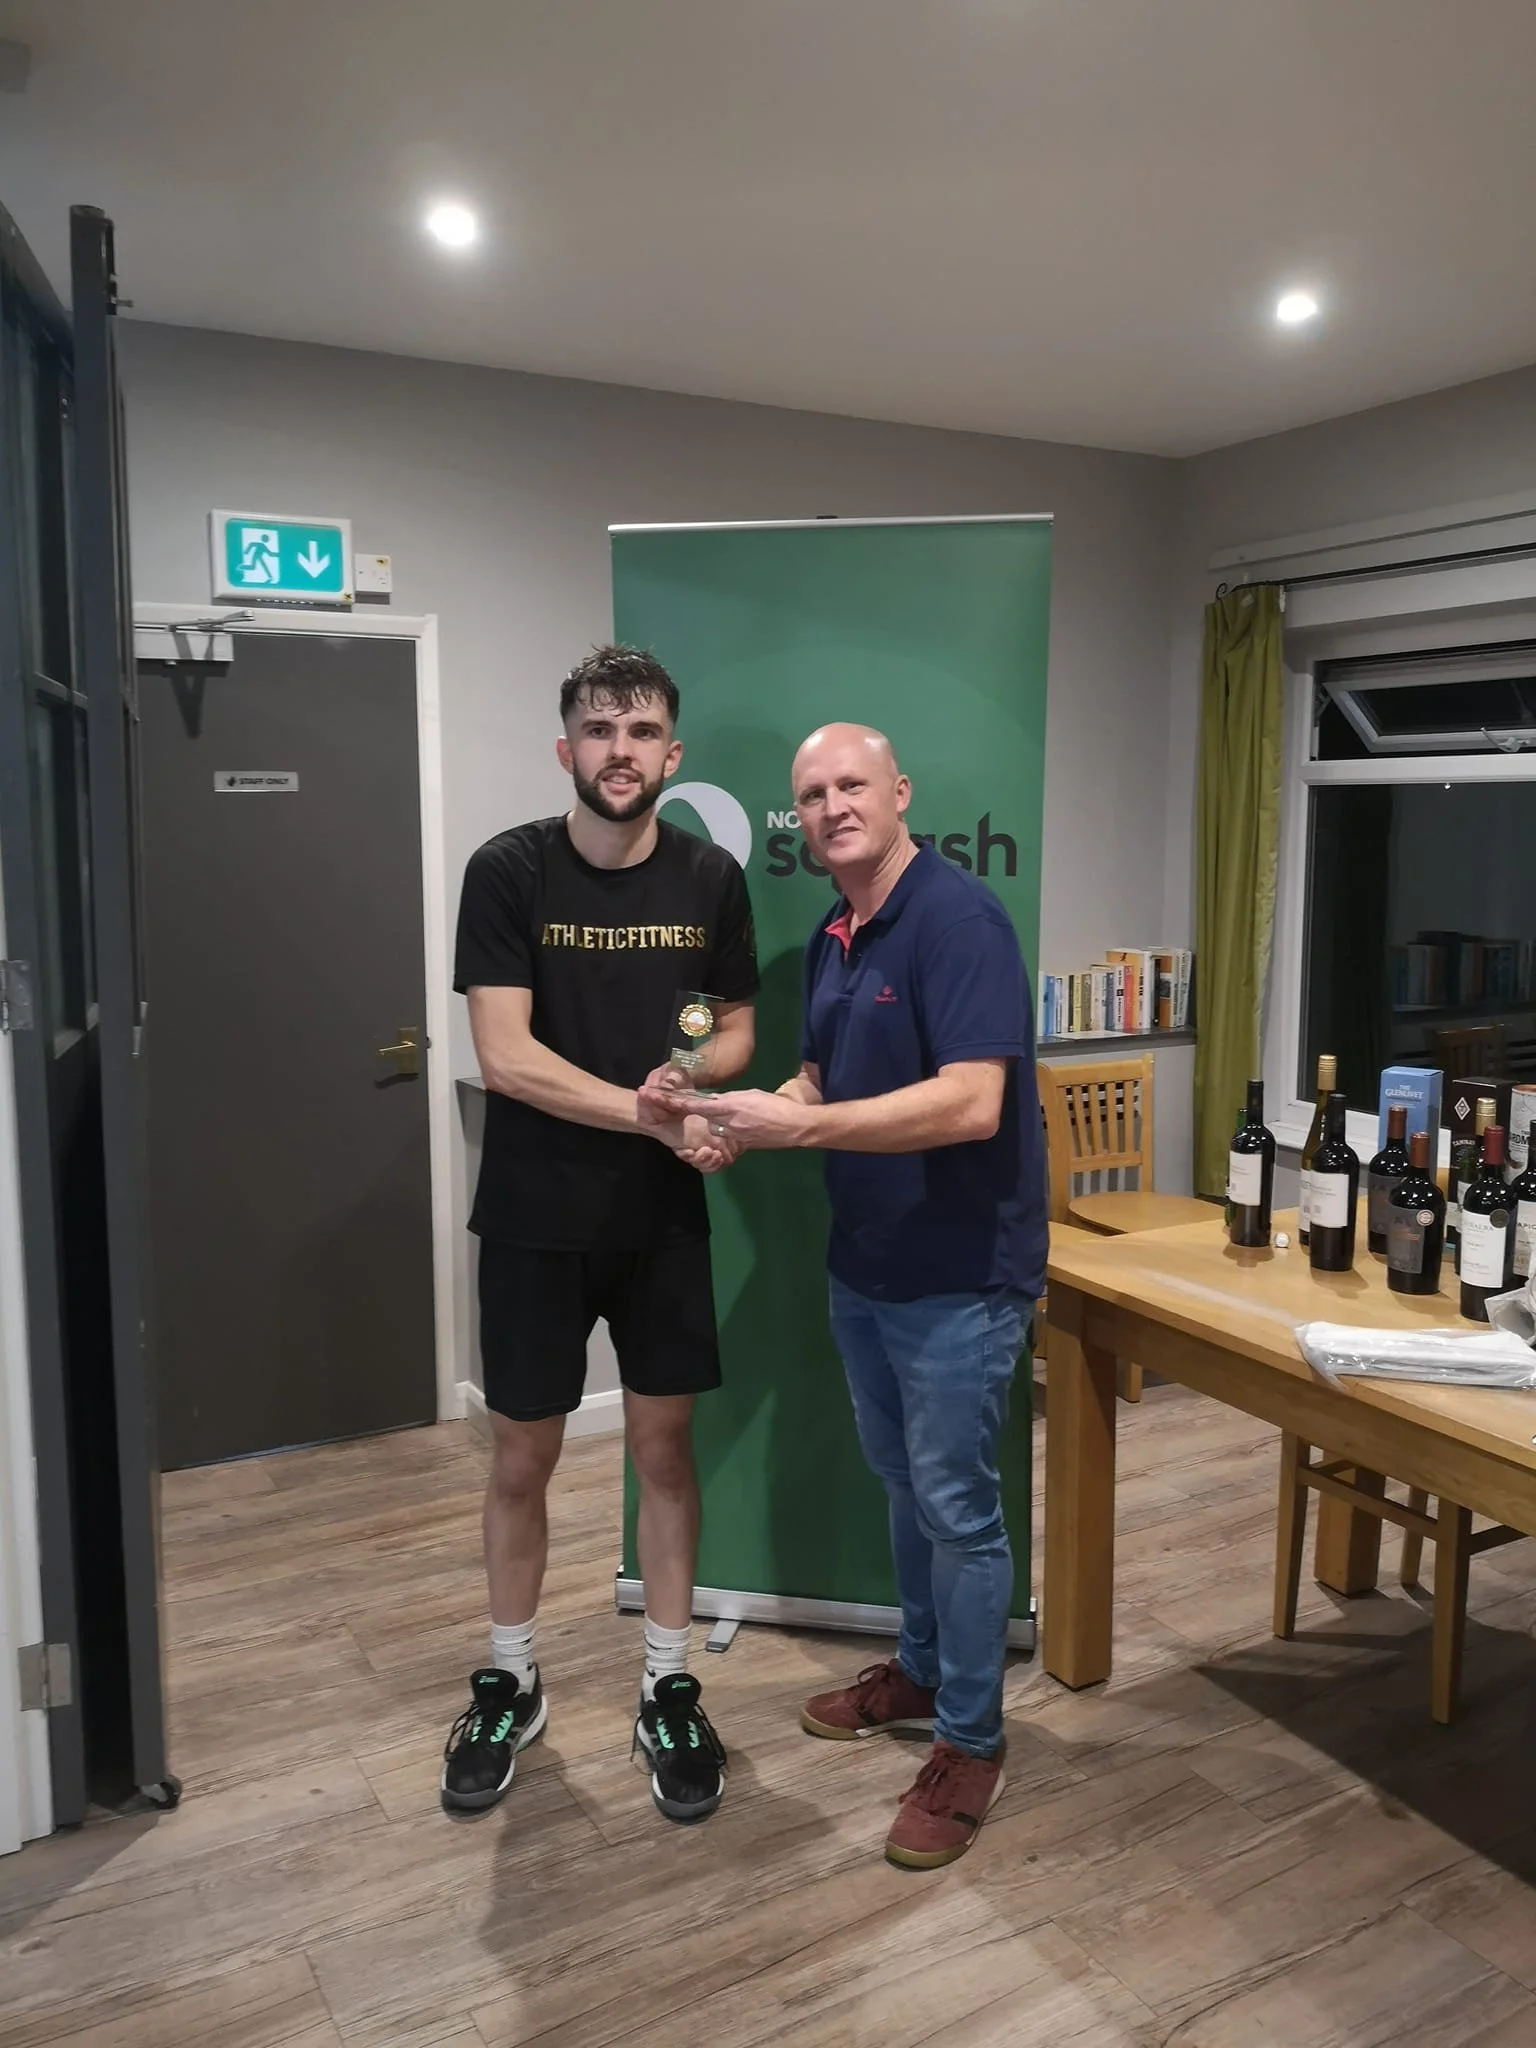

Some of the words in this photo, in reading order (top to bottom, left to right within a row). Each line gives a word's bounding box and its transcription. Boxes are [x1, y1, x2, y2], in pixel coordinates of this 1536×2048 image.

[766, 811, 802, 829] NO
[541, 923, 706, 950] ATHLETICFITNESS
[1385, 1088, 1424, 1099] GLENLIVET
